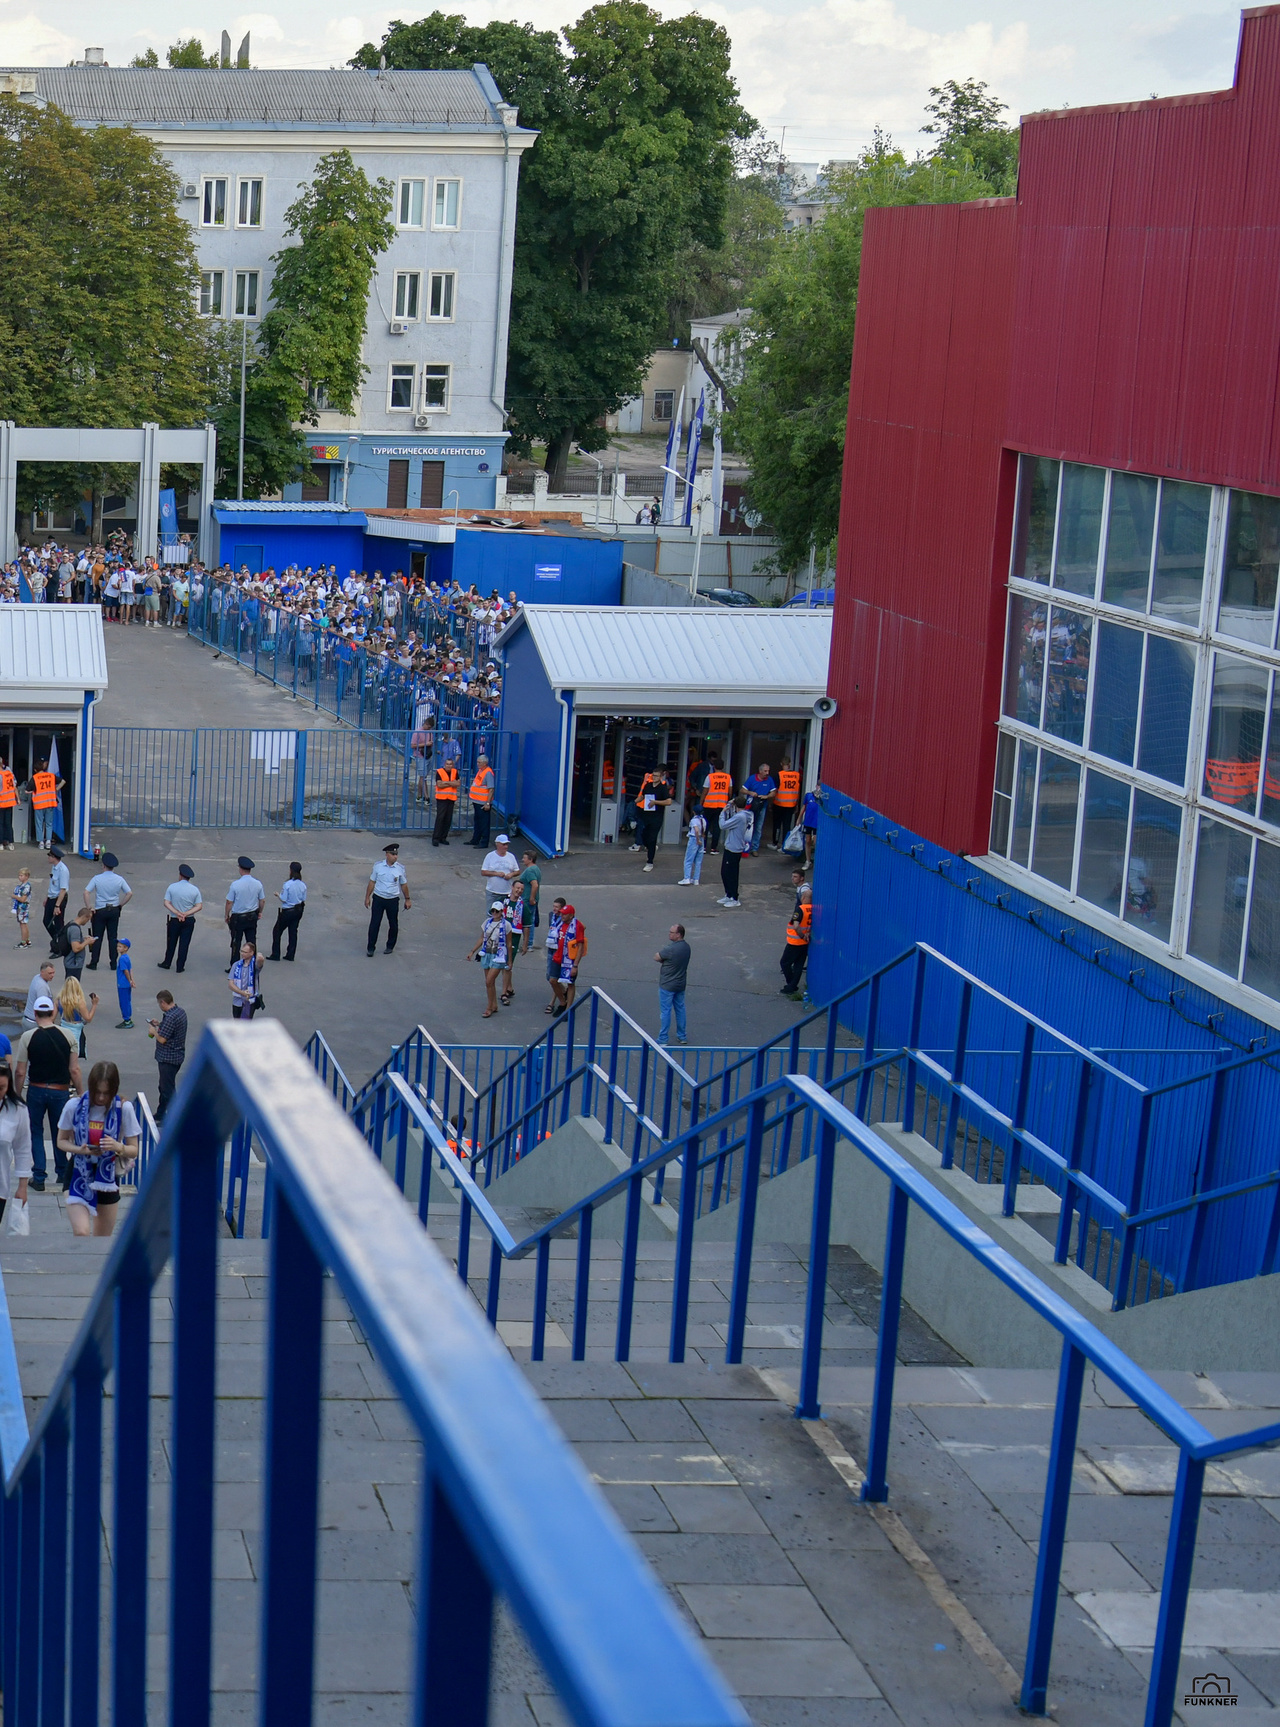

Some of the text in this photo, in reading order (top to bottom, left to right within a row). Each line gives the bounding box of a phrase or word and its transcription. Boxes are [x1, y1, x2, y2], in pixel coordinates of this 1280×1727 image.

[372, 447, 486, 456] ТУРИСТИЧЕСКОЕ АГЕНТСТВО
[713, 781, 727, 790] 219
[783, 780, 797, 790] 182
